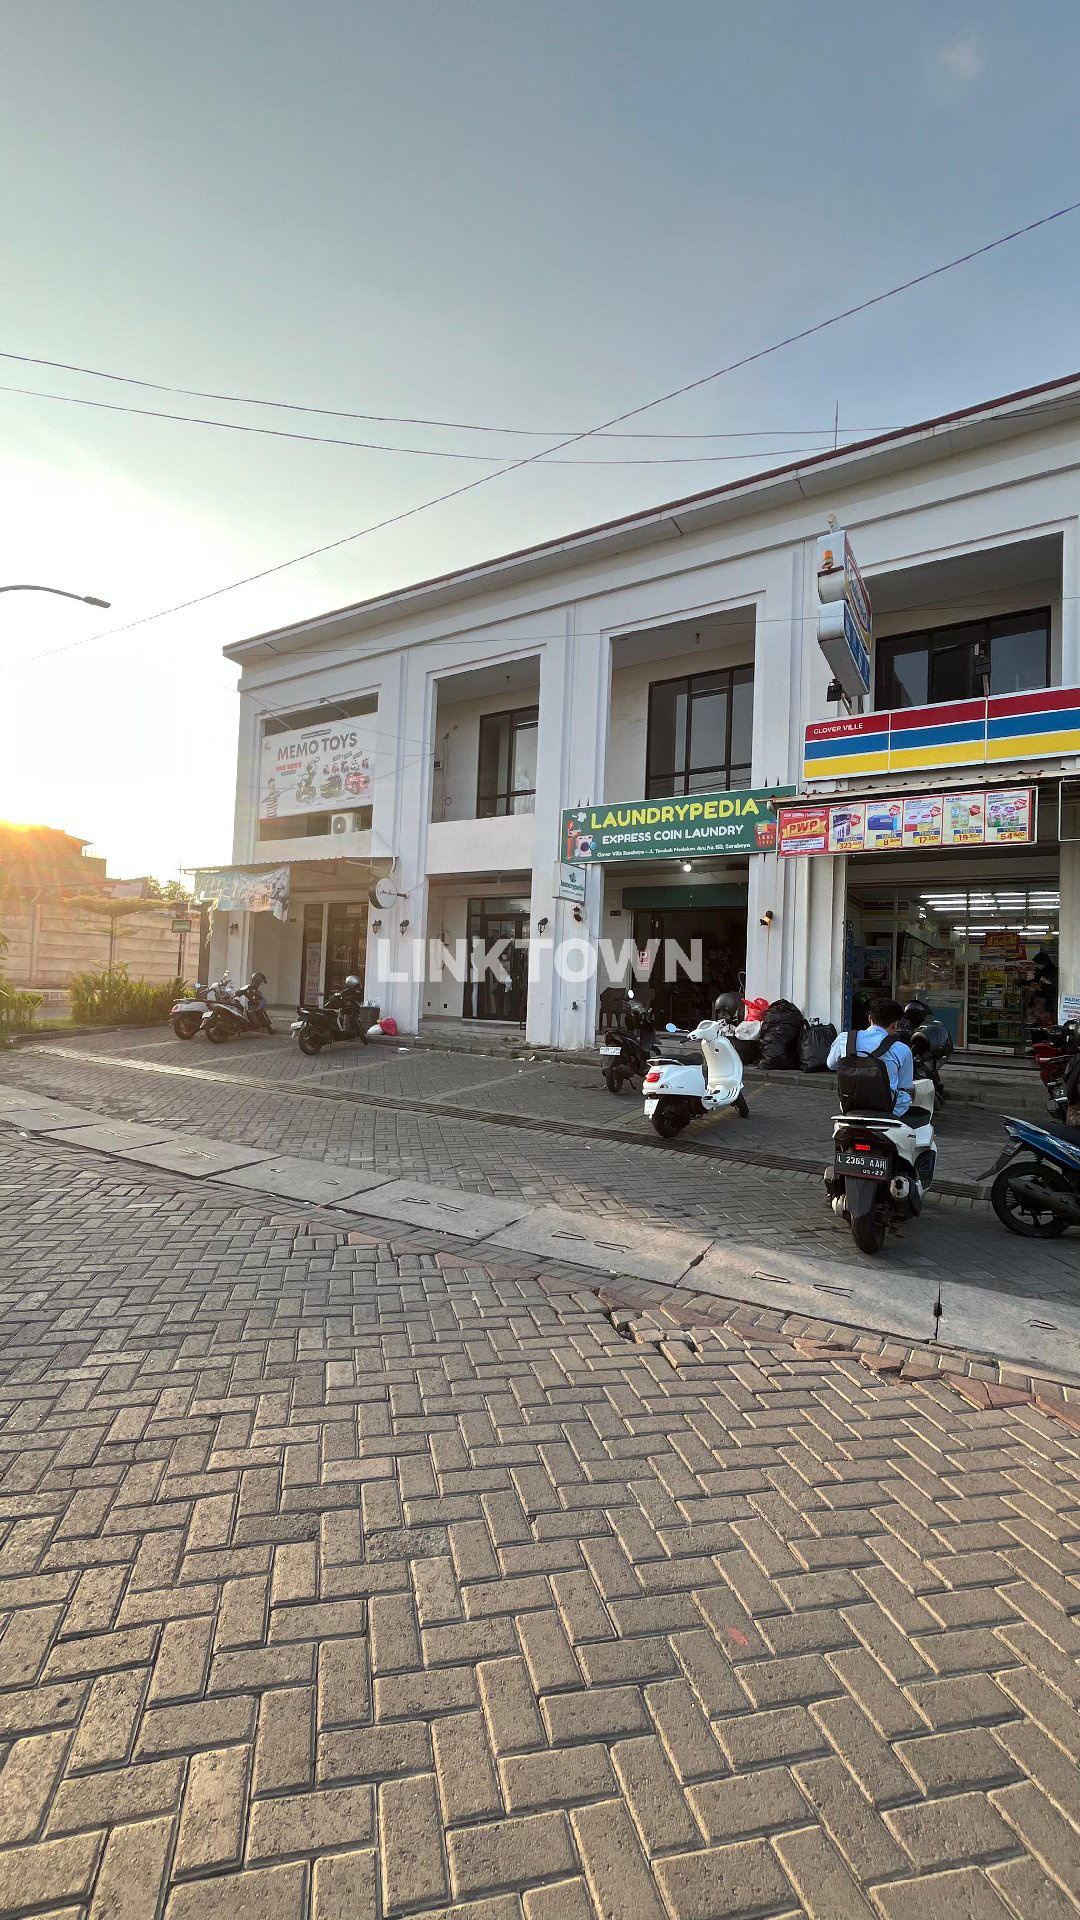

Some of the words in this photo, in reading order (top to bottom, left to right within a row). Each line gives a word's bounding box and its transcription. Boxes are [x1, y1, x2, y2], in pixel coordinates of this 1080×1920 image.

[843, 723, 864, 731] VILLE
[277, 740, 319, 760] MEMO
[322, 732, 358, 752] TOYS
[591, 798, 760, 829] LAUNDRYPEDIA
[602, 832, 651, 845] EXPRESS
[653, 829, 683, 841] COIN
[684, 824, 745, 840] LAUNDRY
[789, 820, 818, 833] PWP
